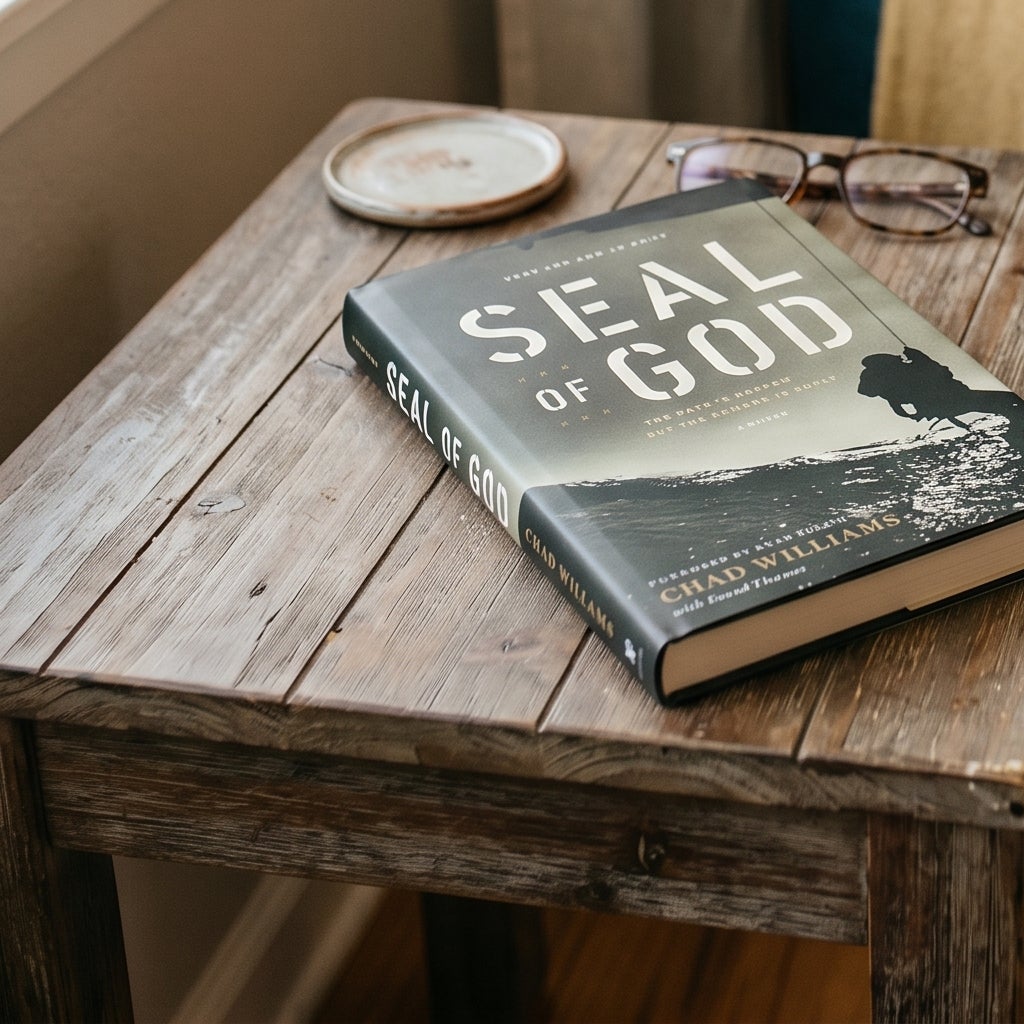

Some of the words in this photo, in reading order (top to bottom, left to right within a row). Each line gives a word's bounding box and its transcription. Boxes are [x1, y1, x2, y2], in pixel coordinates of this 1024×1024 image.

[459, 240, 803, 363] SEAL
[536, 377, 589, 411] OF
[607, 295, 853, 401] GOD
[386, 361, 434, 445] SEAL
[441, 426, 462, 469] OF
[469, 453, 509, 528] GOD
[525, 528, 556, 570] CHAD
[660, 566, 747, 604] CHAD
[751, 514, 901, 571] WILLIAMS
[673, 598, 704, 618] with
